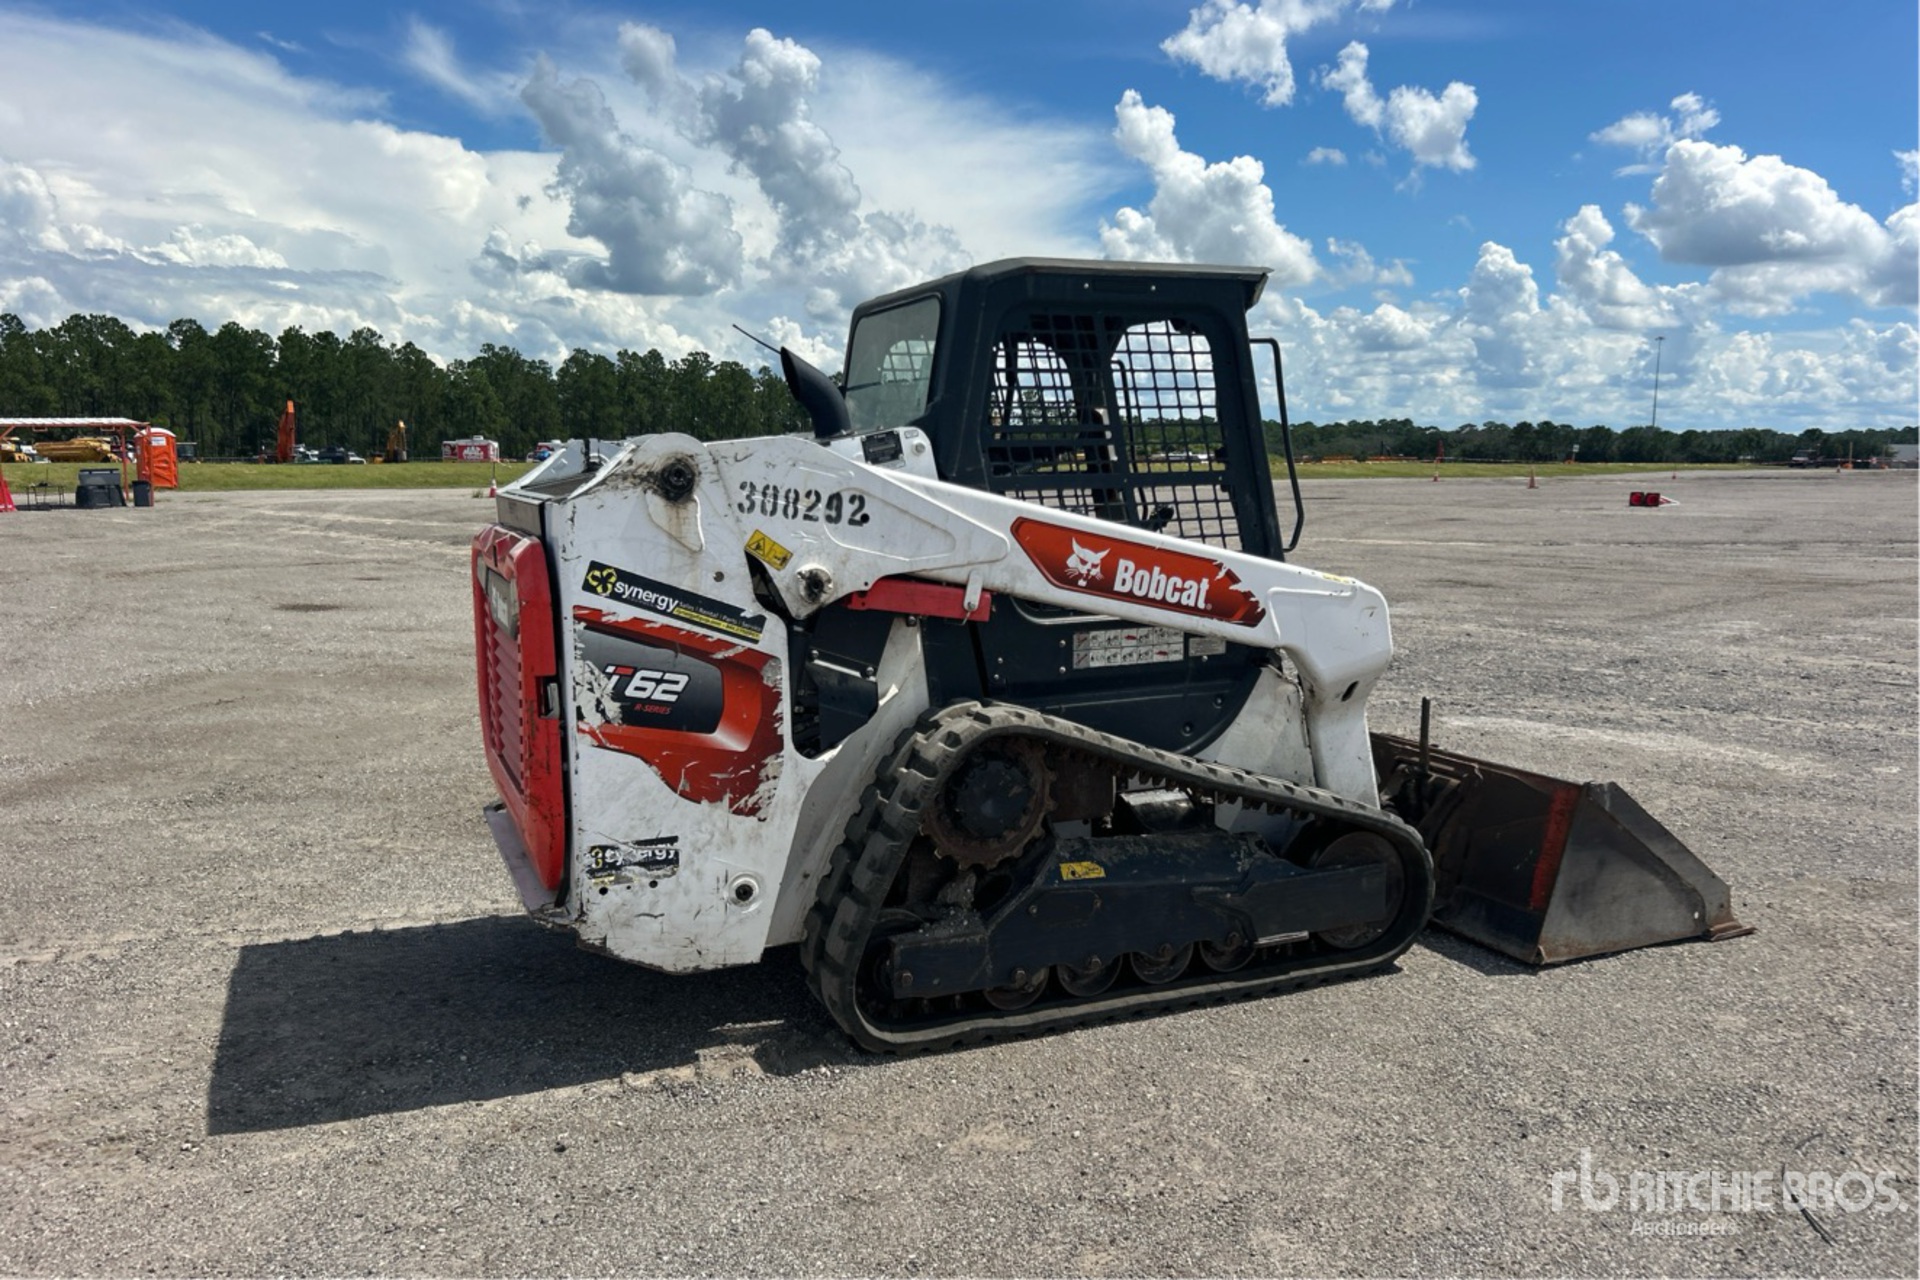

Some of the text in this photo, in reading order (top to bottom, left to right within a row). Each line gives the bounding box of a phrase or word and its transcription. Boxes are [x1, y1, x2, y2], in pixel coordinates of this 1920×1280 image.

[614, 581, 679, 612] synergy
[1113, 558, 1210, 610] Bobcat
[604, 665, 690, 702] T62
